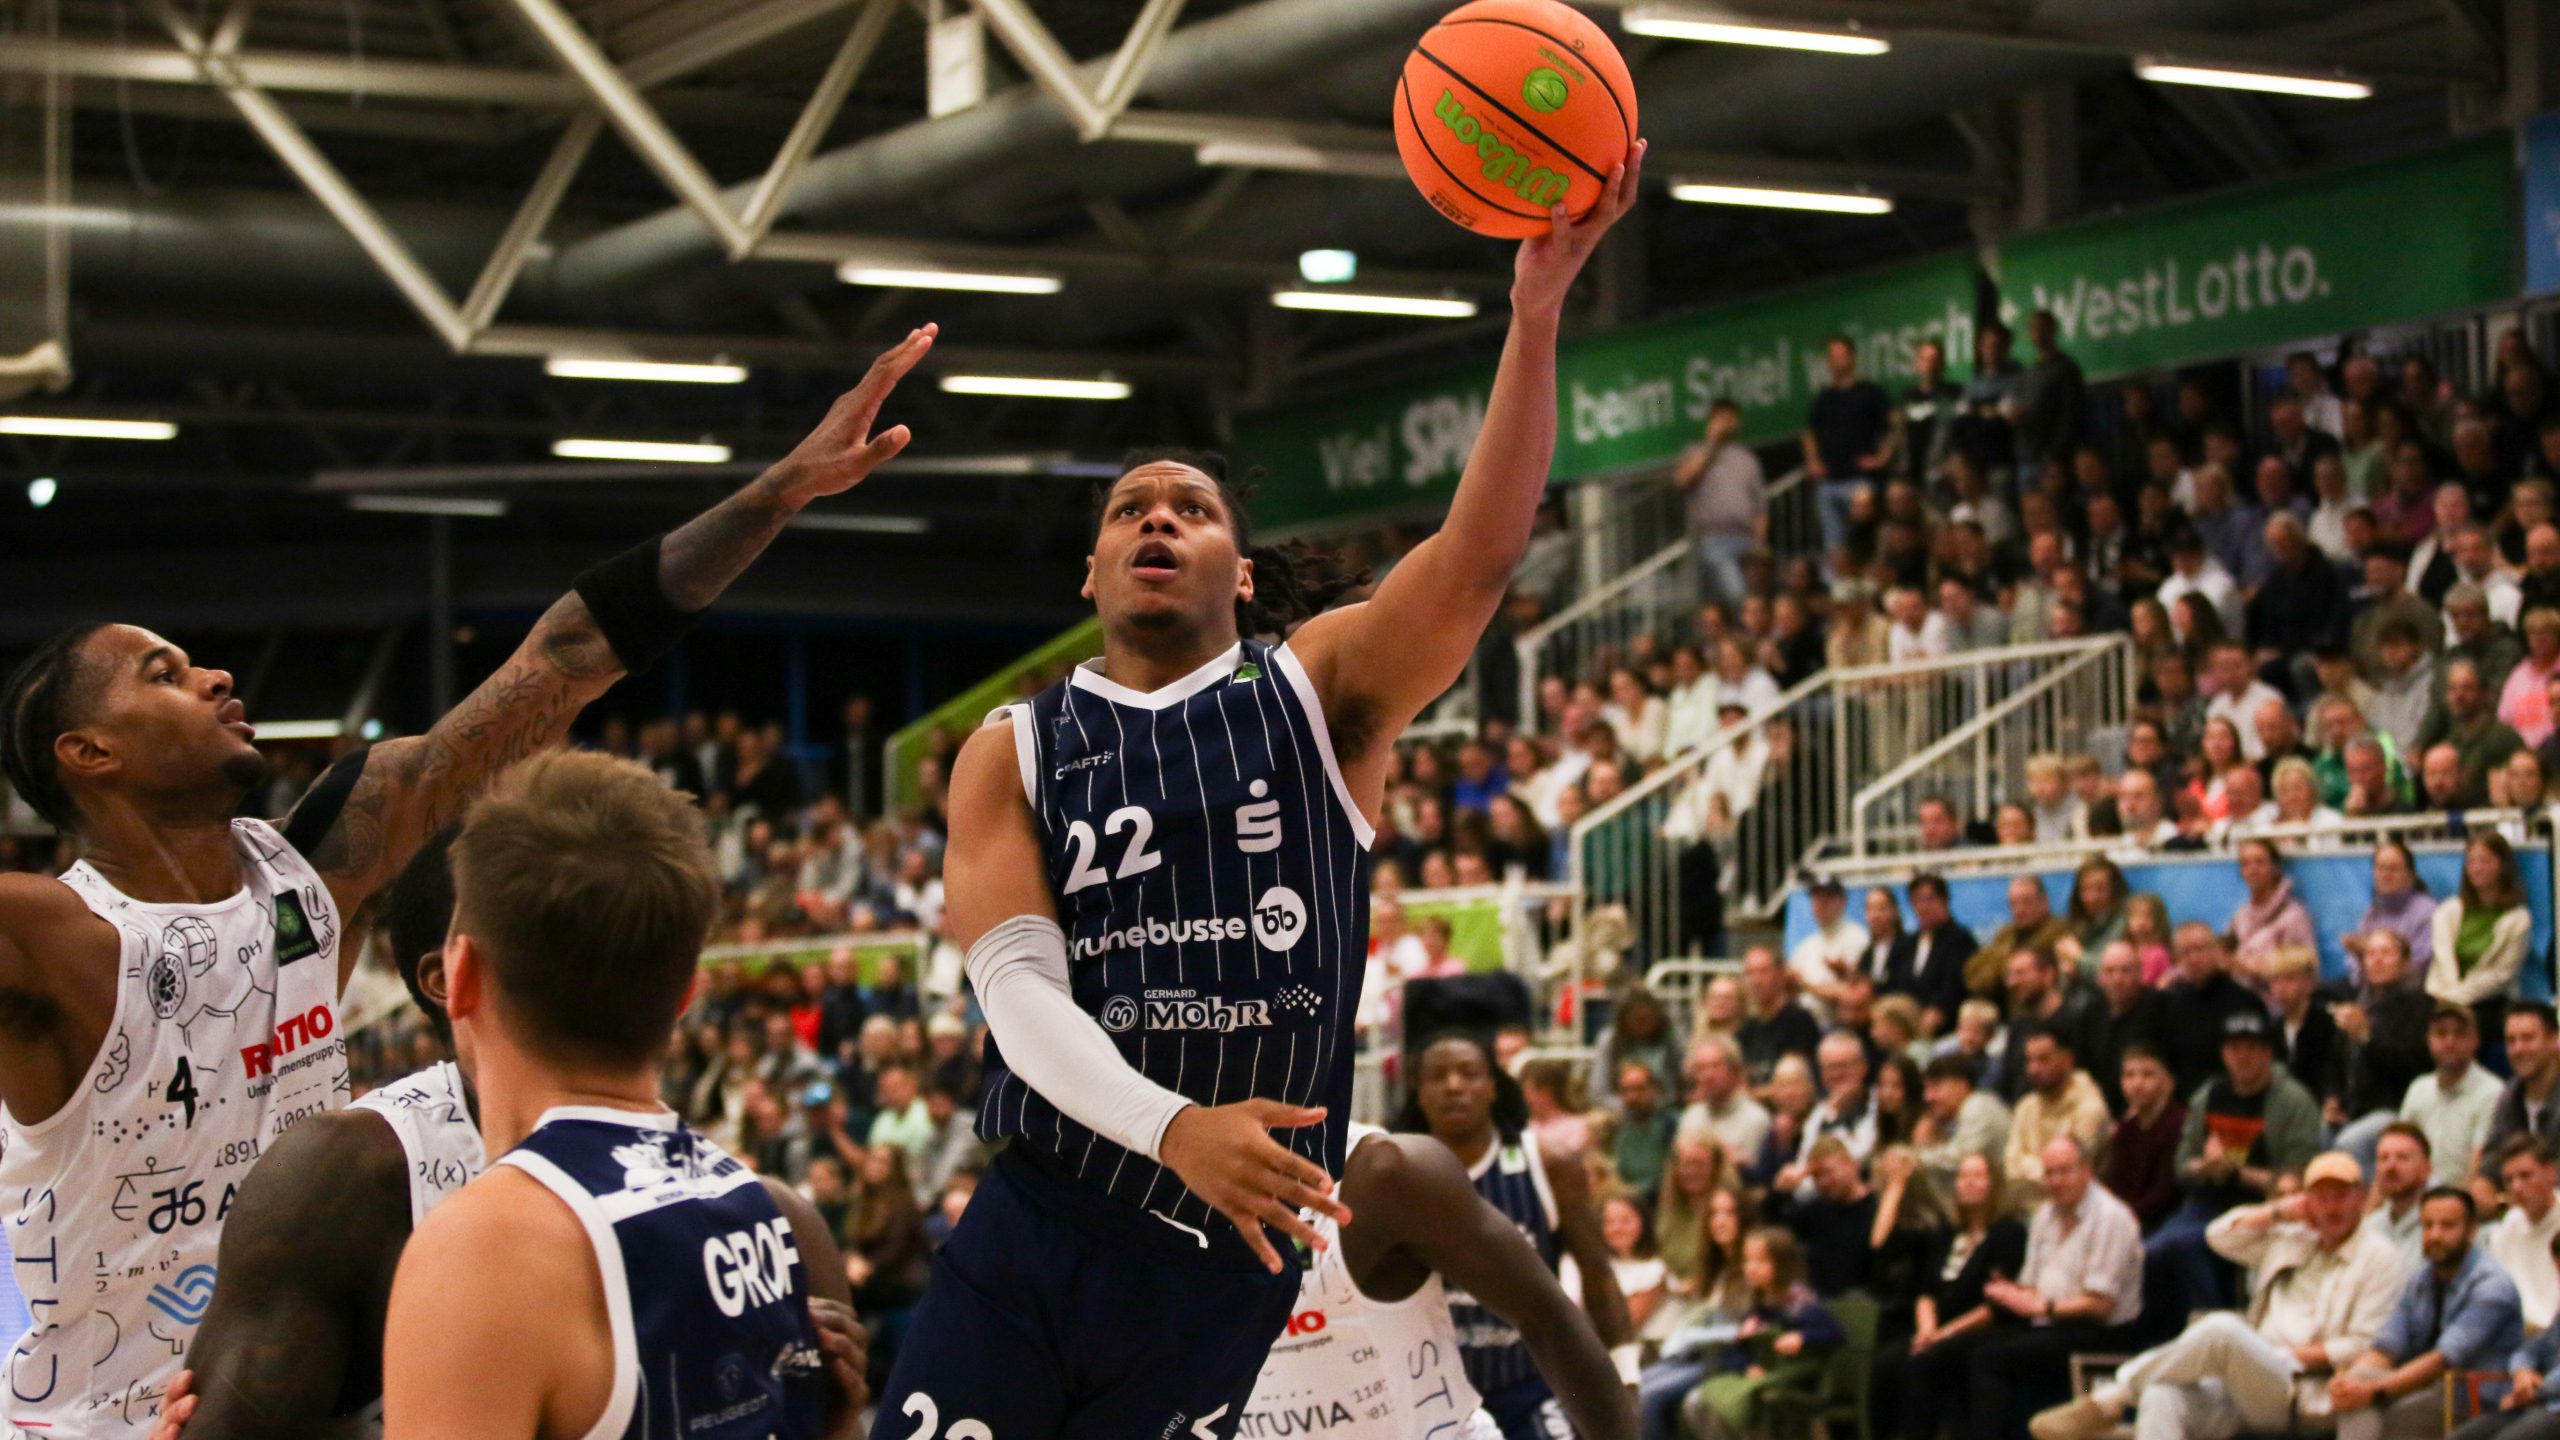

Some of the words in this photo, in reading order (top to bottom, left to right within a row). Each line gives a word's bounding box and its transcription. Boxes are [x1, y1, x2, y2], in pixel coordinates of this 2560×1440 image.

[1434, 88, 1571, 208] Wilson
[1319, 422, 1391, 492] Viel
[1402, 393, 1488, 487] SPA
[1572, 374, 1674, 442] beim
[1684, 335, 1791, 422] Spiel
[2032, 244, 2331, 343] WestLotto.
[1063, 806, 1162, 895] 22
[1144, 989, 1197, 999] GERHARD
[166, 1056, 199, 1130] 4
